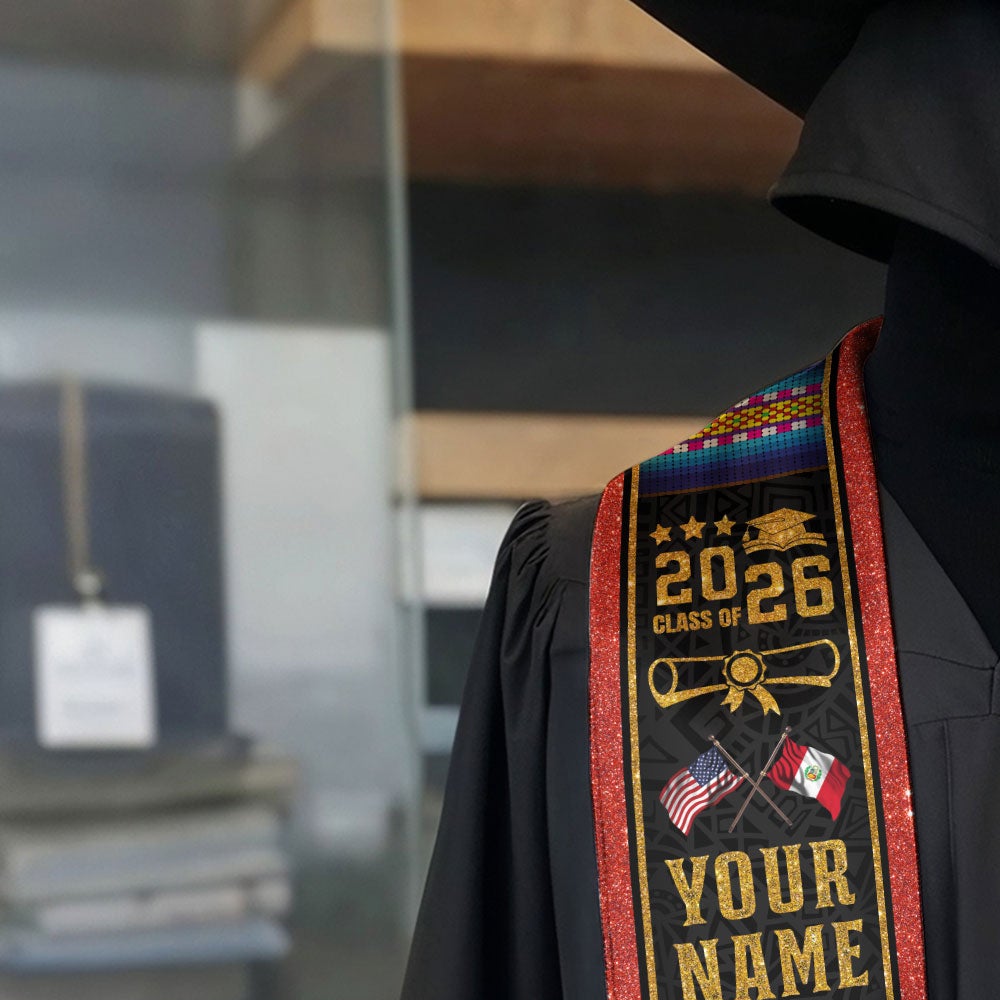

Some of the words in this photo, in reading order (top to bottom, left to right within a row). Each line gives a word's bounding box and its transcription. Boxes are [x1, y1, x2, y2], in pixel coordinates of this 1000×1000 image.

[652, 611, 713, 634] CLASS
[718, 606, 742, 628] OF
[655, 546, 835, 625] 2026
[664, 838, 856, 927] YOUR
